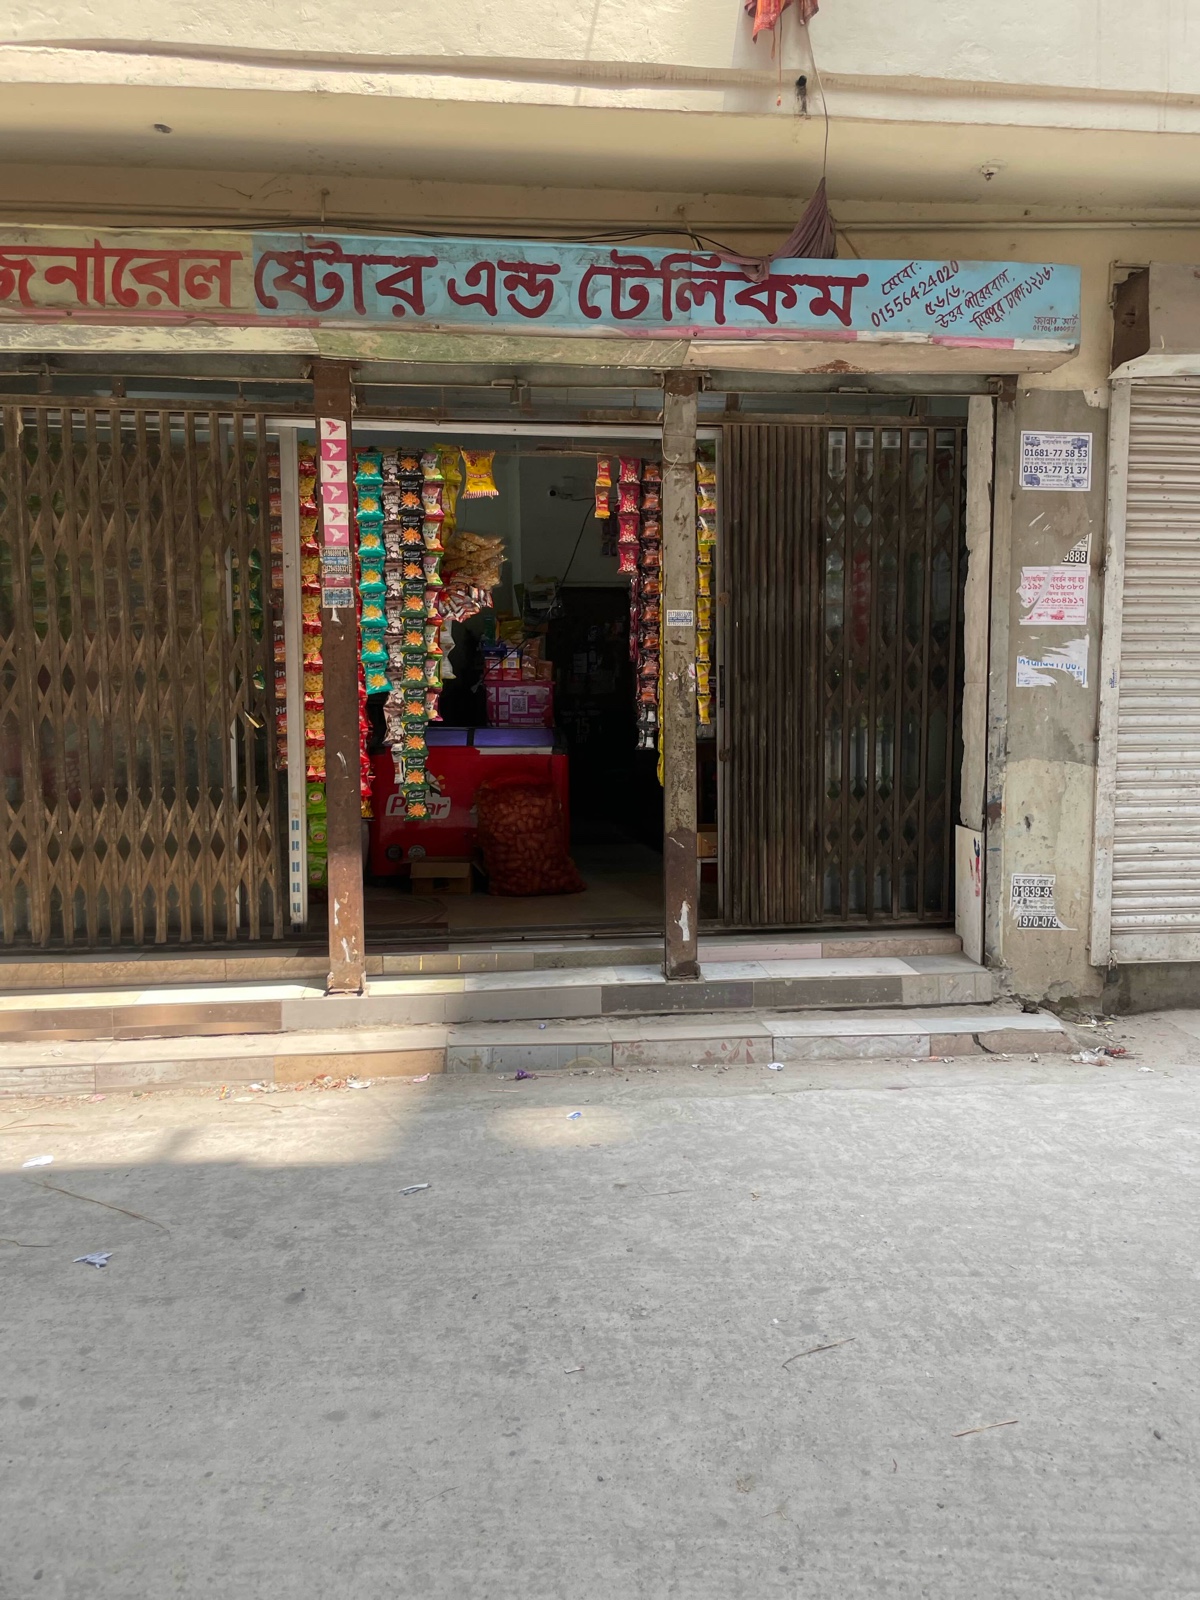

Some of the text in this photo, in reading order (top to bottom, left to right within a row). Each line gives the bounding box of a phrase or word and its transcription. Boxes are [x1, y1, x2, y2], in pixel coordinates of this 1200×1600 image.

[447, 260, 561, 318] এন্ড
[578, 249, 870, 328] টেলিকম
[870, 260, 960, 328] 01556424020
[1024, 448, 1063, 457] 01681-77
[1065, 449, 1075, 457] 58
[1023, 465, 1087, 474] 01951-77 51 37
[390, 795, 448, 816] Par
